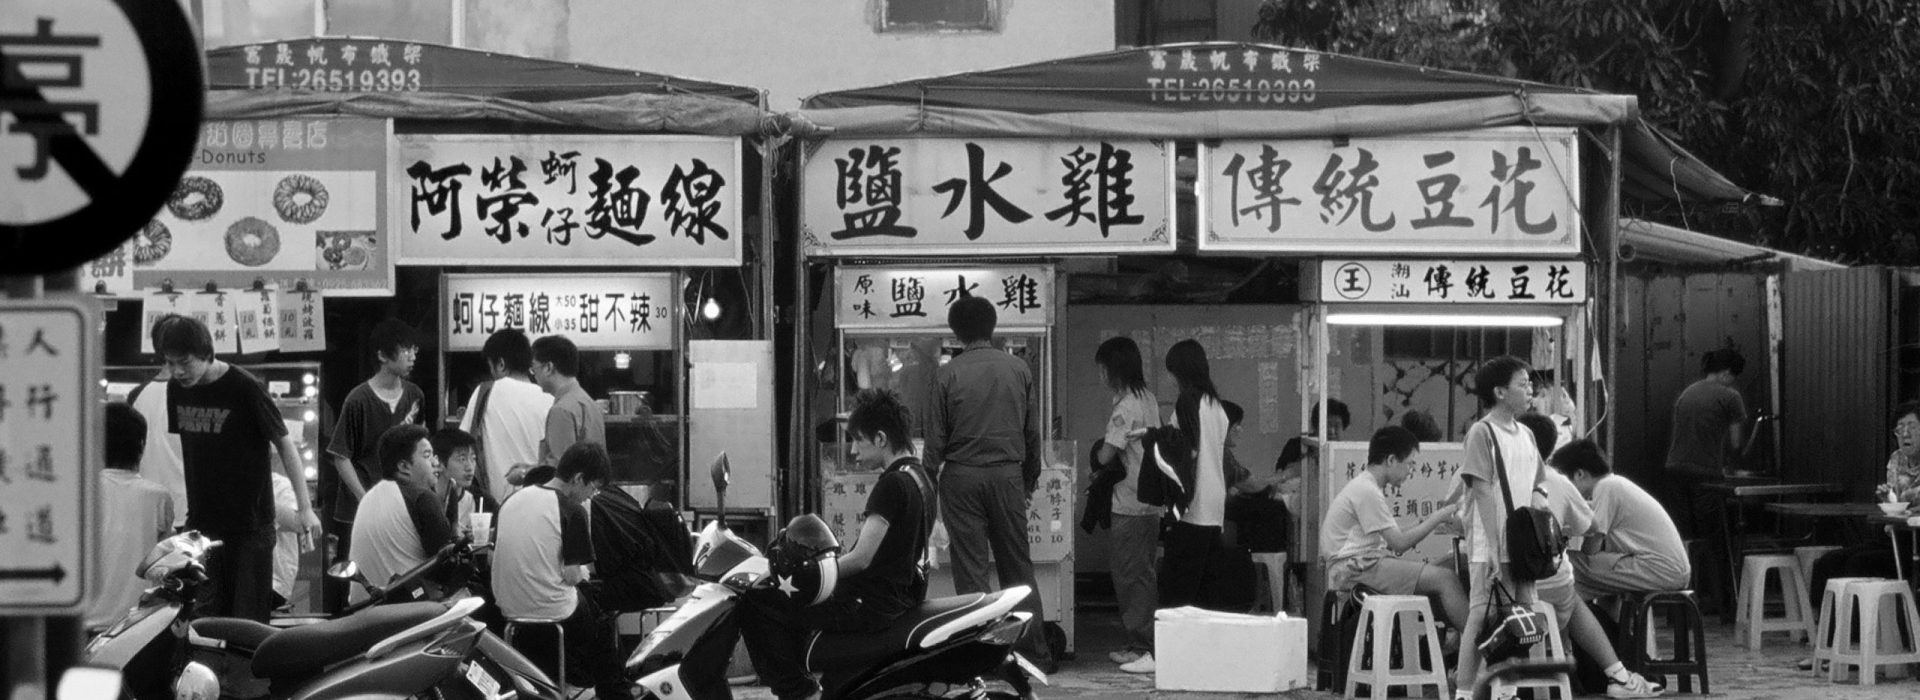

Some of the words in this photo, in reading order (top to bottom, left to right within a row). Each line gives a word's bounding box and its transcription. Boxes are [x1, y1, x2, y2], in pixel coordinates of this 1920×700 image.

[246, 68, 421, 92] TEL:26519393
[831, 142, 1144, 241] 鹽水雞
[1222, 144, 1557, 235] 傳統豆花
[1424, 264, 1574, 299] 傳統豆花
[453, 292, 550, 334] 蚵仔麵線
[579, 292, 652, 333] 甜不辣
